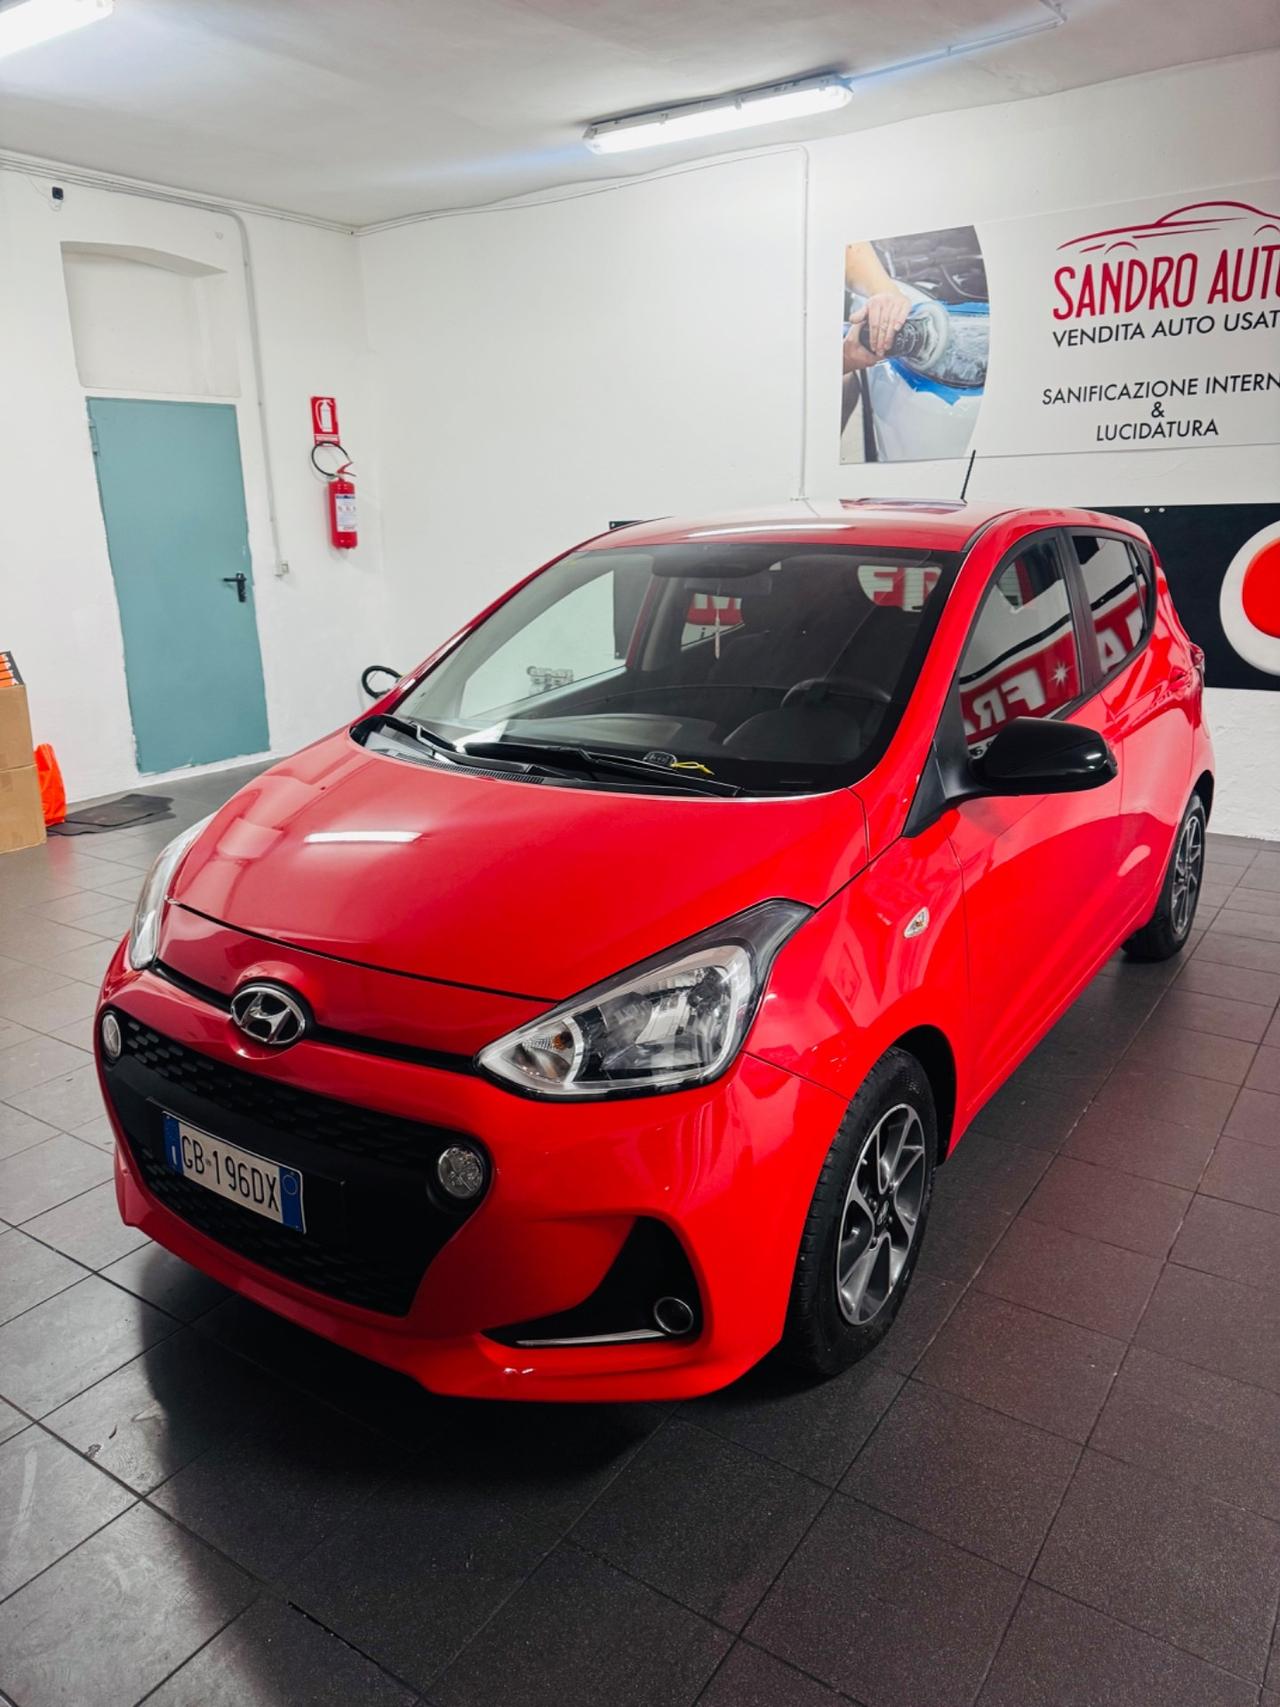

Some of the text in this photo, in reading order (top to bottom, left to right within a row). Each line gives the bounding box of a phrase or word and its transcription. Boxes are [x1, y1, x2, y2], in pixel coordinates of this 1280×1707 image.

[1053, 252, 1198, 320] SANDRO
[1053, 322, 1145, 348] VENDITA
[1152, 315, 1215, 338] AUTO
[1042, 378, 1199, 405] SANIFICAZIONE
[1151, 401, 1165, 418] &
[1096, 419, 1219, 441] LUCIDATURA
